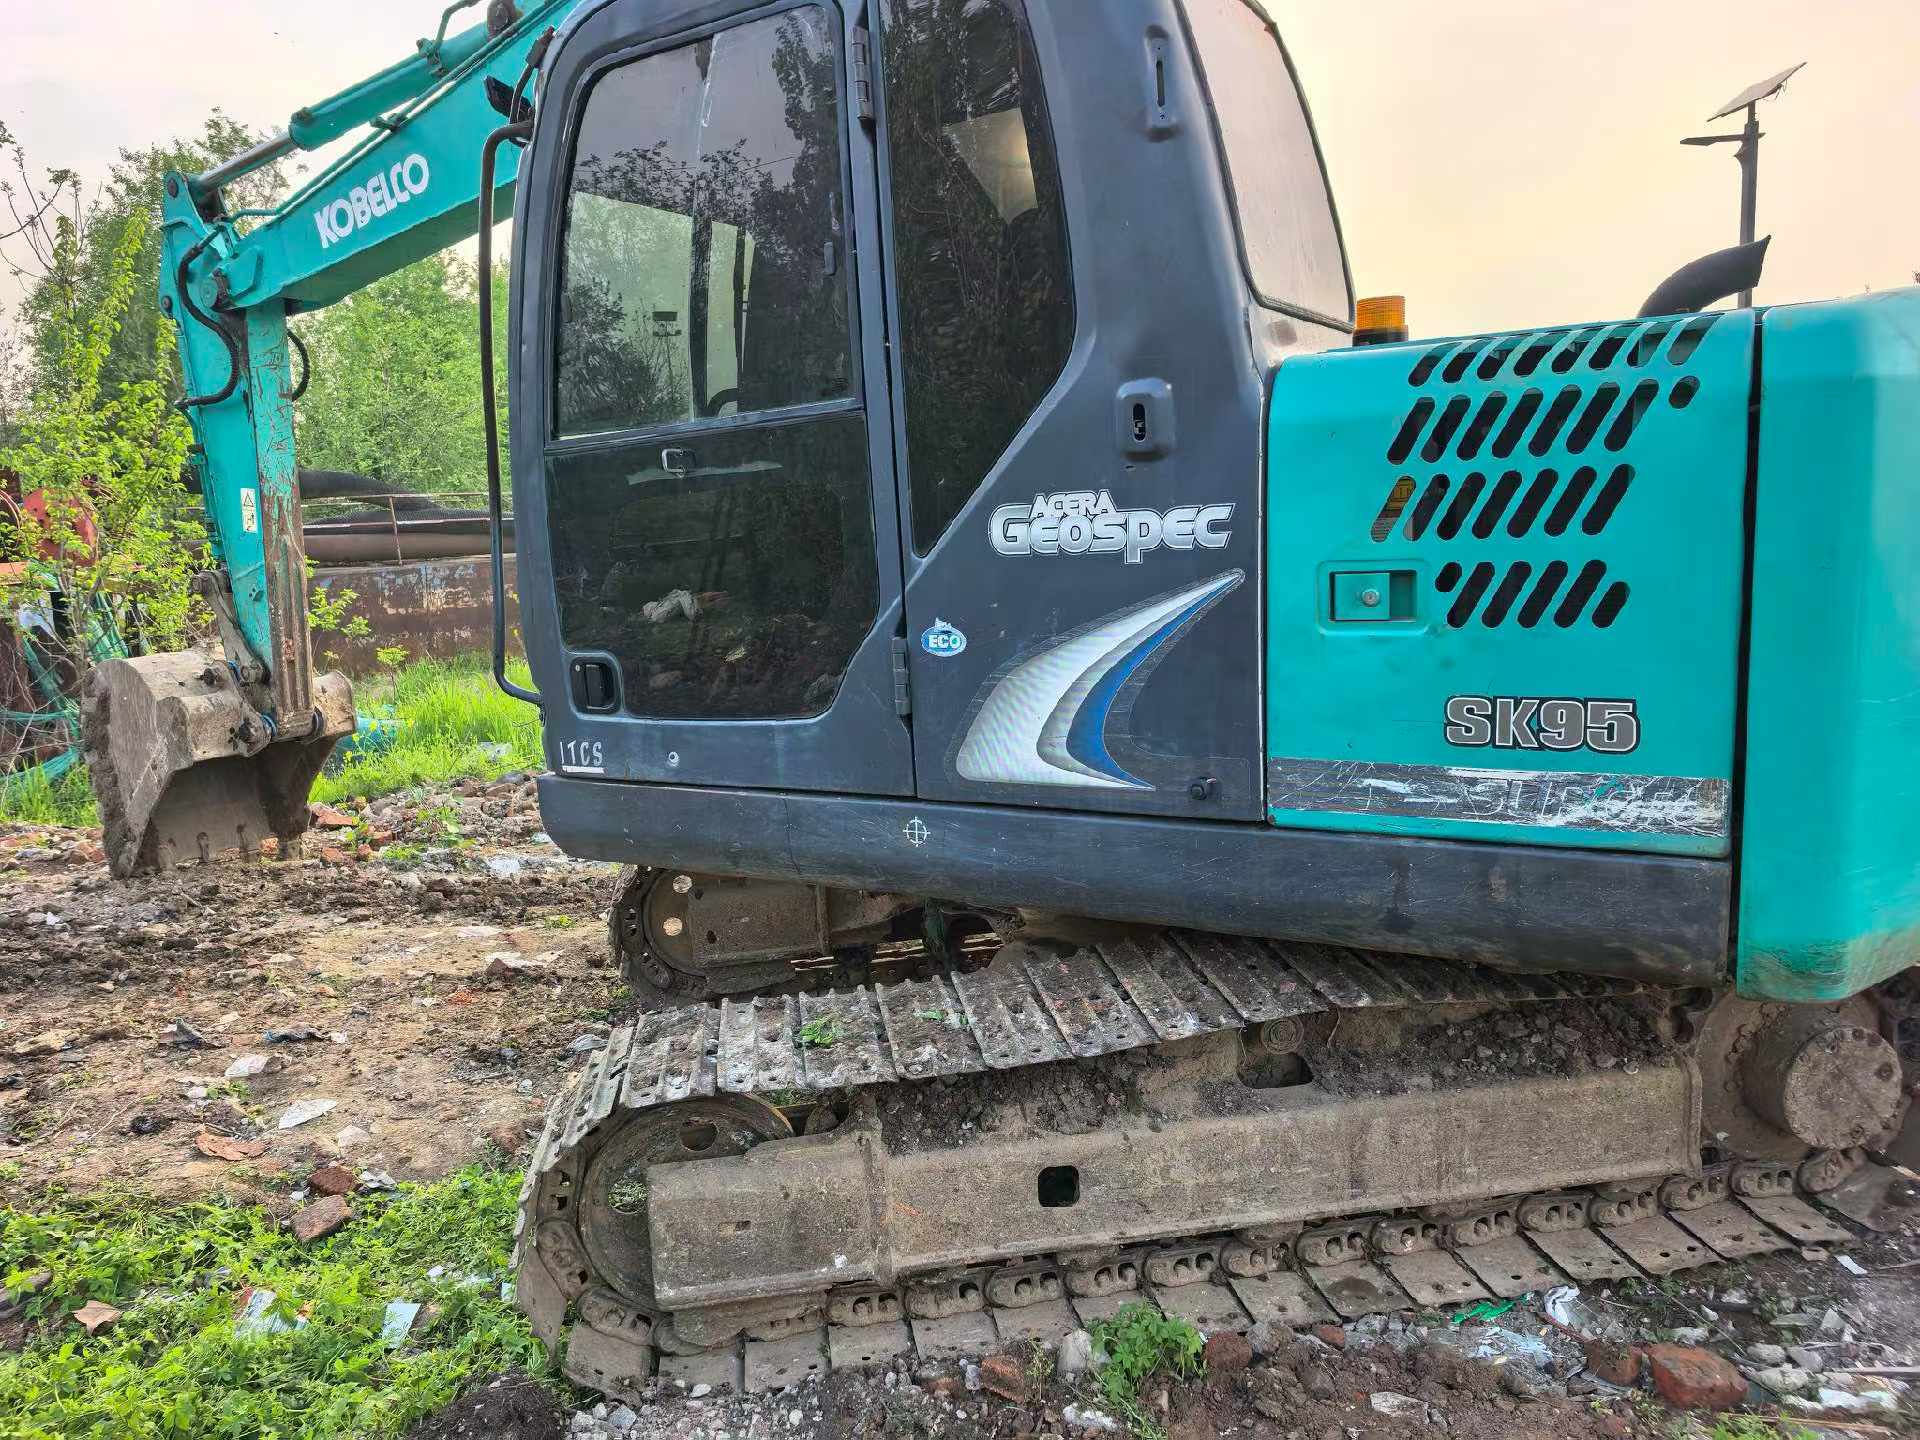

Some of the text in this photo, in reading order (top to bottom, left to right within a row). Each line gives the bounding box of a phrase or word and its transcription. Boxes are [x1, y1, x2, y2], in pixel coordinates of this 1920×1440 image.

[313, 153, 430, 249] KOBELCO
[1030, 489, 1118, 518] ACERA
[928, 634, 961, 649] ECO
[1445, 695, 1640, 753] SK95
[559, 740, 604, 767] ITCS
